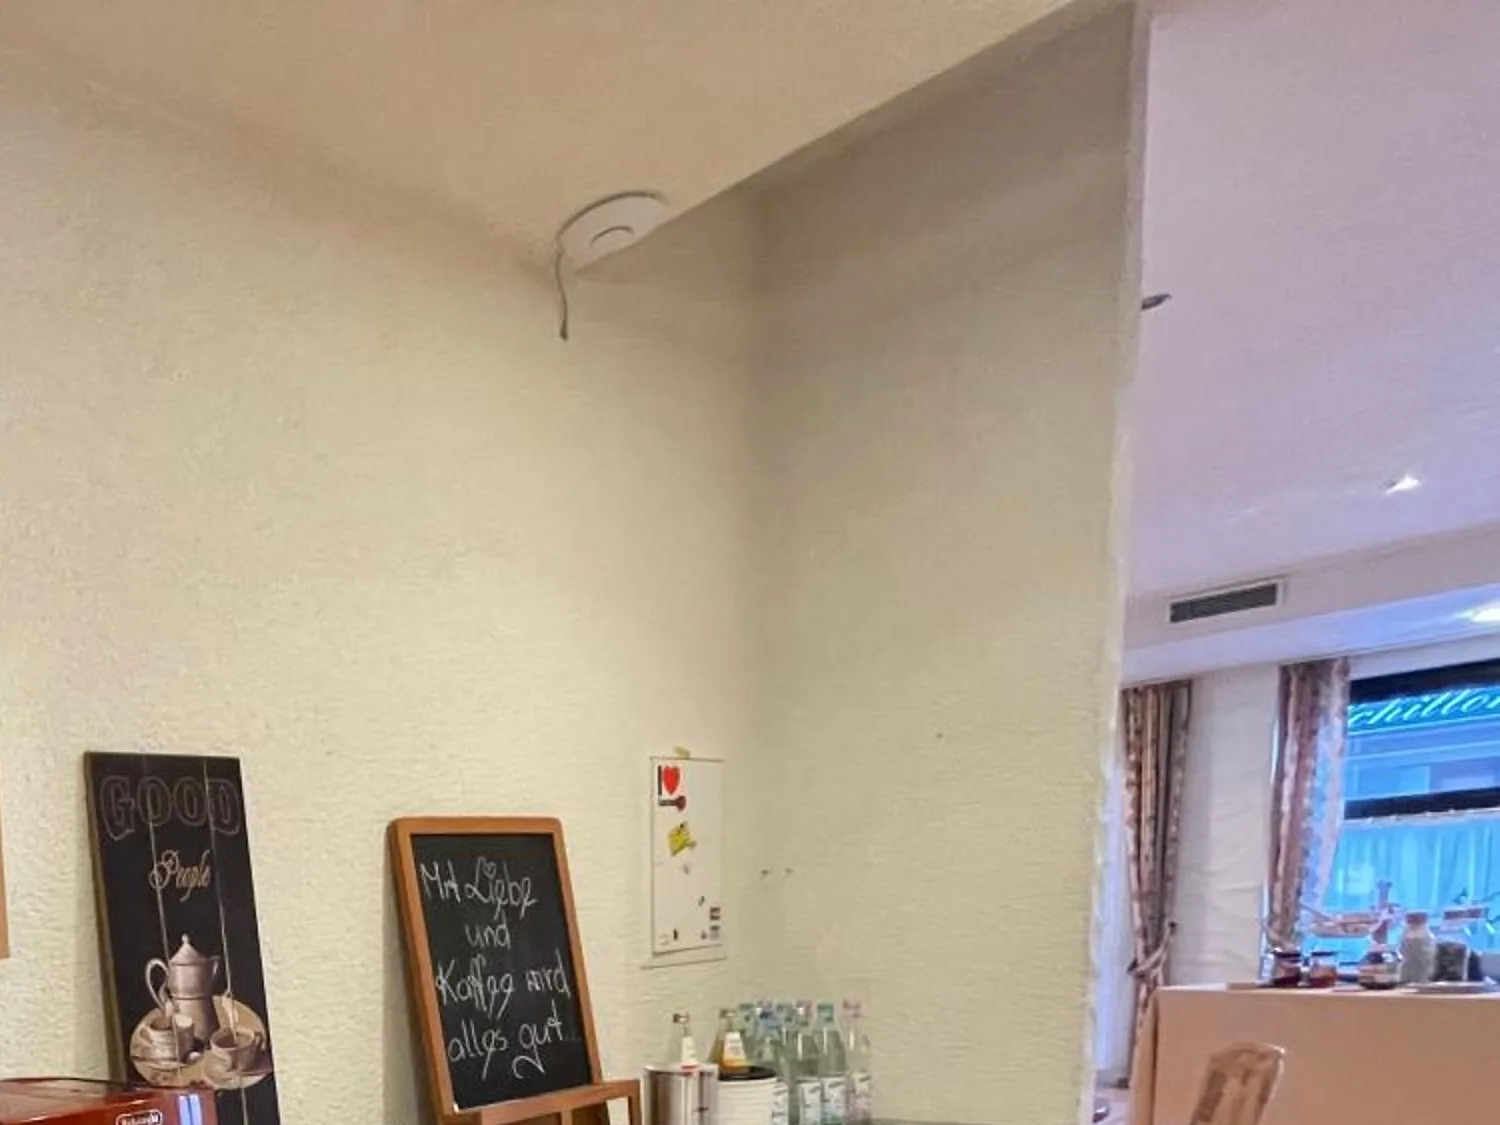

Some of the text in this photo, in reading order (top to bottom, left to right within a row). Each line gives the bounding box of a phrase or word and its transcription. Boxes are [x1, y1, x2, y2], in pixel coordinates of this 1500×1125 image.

[100, 774, 240, 841] GOOD
[419, 855, 539, 921] Mit Liebe
[464, 909, 512, 950] und
[435, 948, 572, 1020] Kaffee wird
[447, 1018, 508, 1081] alles
